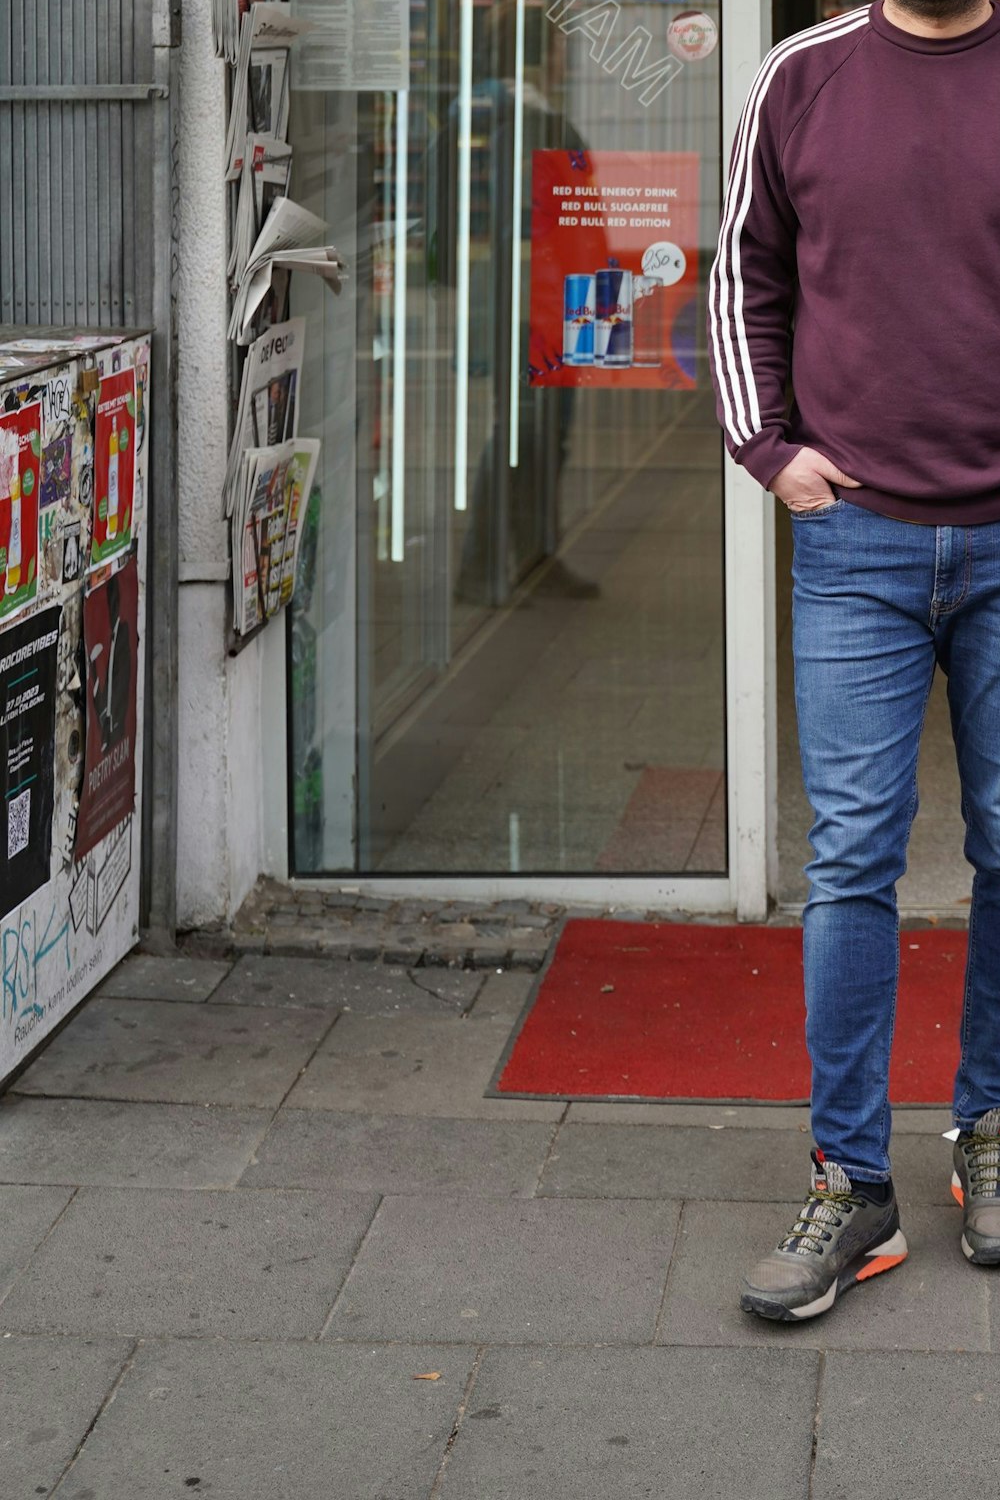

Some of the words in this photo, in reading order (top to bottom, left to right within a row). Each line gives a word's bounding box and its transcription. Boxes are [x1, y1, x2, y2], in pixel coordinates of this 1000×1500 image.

[553, 186, 572, 196] RED
[575, 186, 599, 197] BULL
[601, 187, 641, 197] ENERGY
[644, 187, 677, 198] DRINK
[561, 201, 581, 211] RED
[584, 201, 607, 211] BULL
[610, 202, 668, 212] SUGARFREE
[558, 216, 578, 226] RED
[581, 217, 605, 227] BULL
[607, 217, 627, 227] RED
[629, 218, 671, 228] EDITION
[673, 259, 681, 269] €
[88, 749, 113, 797] POETRY
[112, 736, 131, 770] SLAM
[48, 983, 66, 1012] kann
